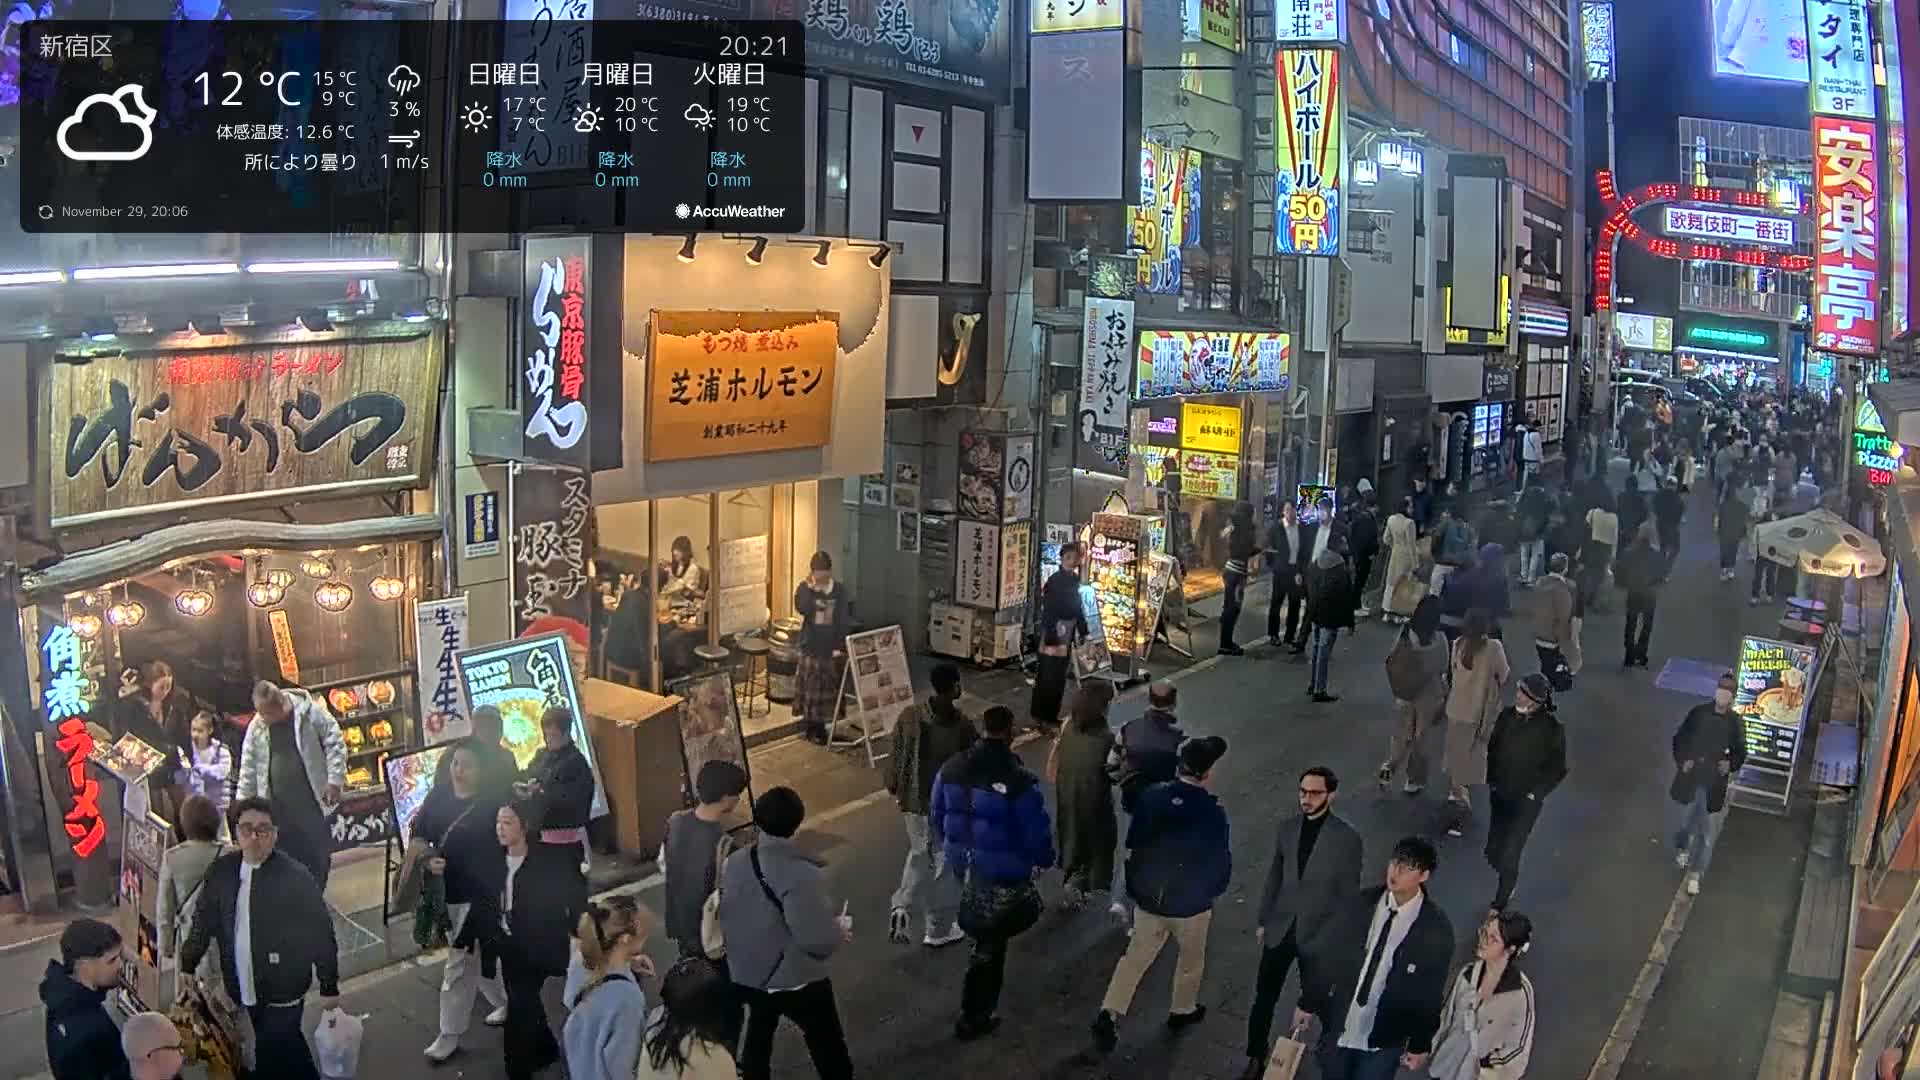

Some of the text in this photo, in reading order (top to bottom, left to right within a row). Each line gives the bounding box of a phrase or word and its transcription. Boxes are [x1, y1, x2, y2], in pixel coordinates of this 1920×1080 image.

[1817, 0, 1843, 70] タイ
[1294, 52, 1322, 190] ハイボール
[1832, 96, 1856, 112] 3F
[1293, 223, 1321, 251] 円
[1669, 210, 1790, 243] 歌舞伎町一番街
[1816, 125, 1876, 330] 安楽亭
[560, 255, 585, 400] 東京豚骨
[1100, 308, 1128, 415] お好み焼き
[668, 366, 823, 406] 芝浦ホルモン
[66, 379, 407, 493] ばんから
[1855, 433, 1896, 451] Tratt
[561, 477, 590, 599] スタミナ
[465, 659, 510, 681] TOKYO
[468, 672, 512, 694] RAMEN
[43, 624, 106, 860] 角煮ラーメン
